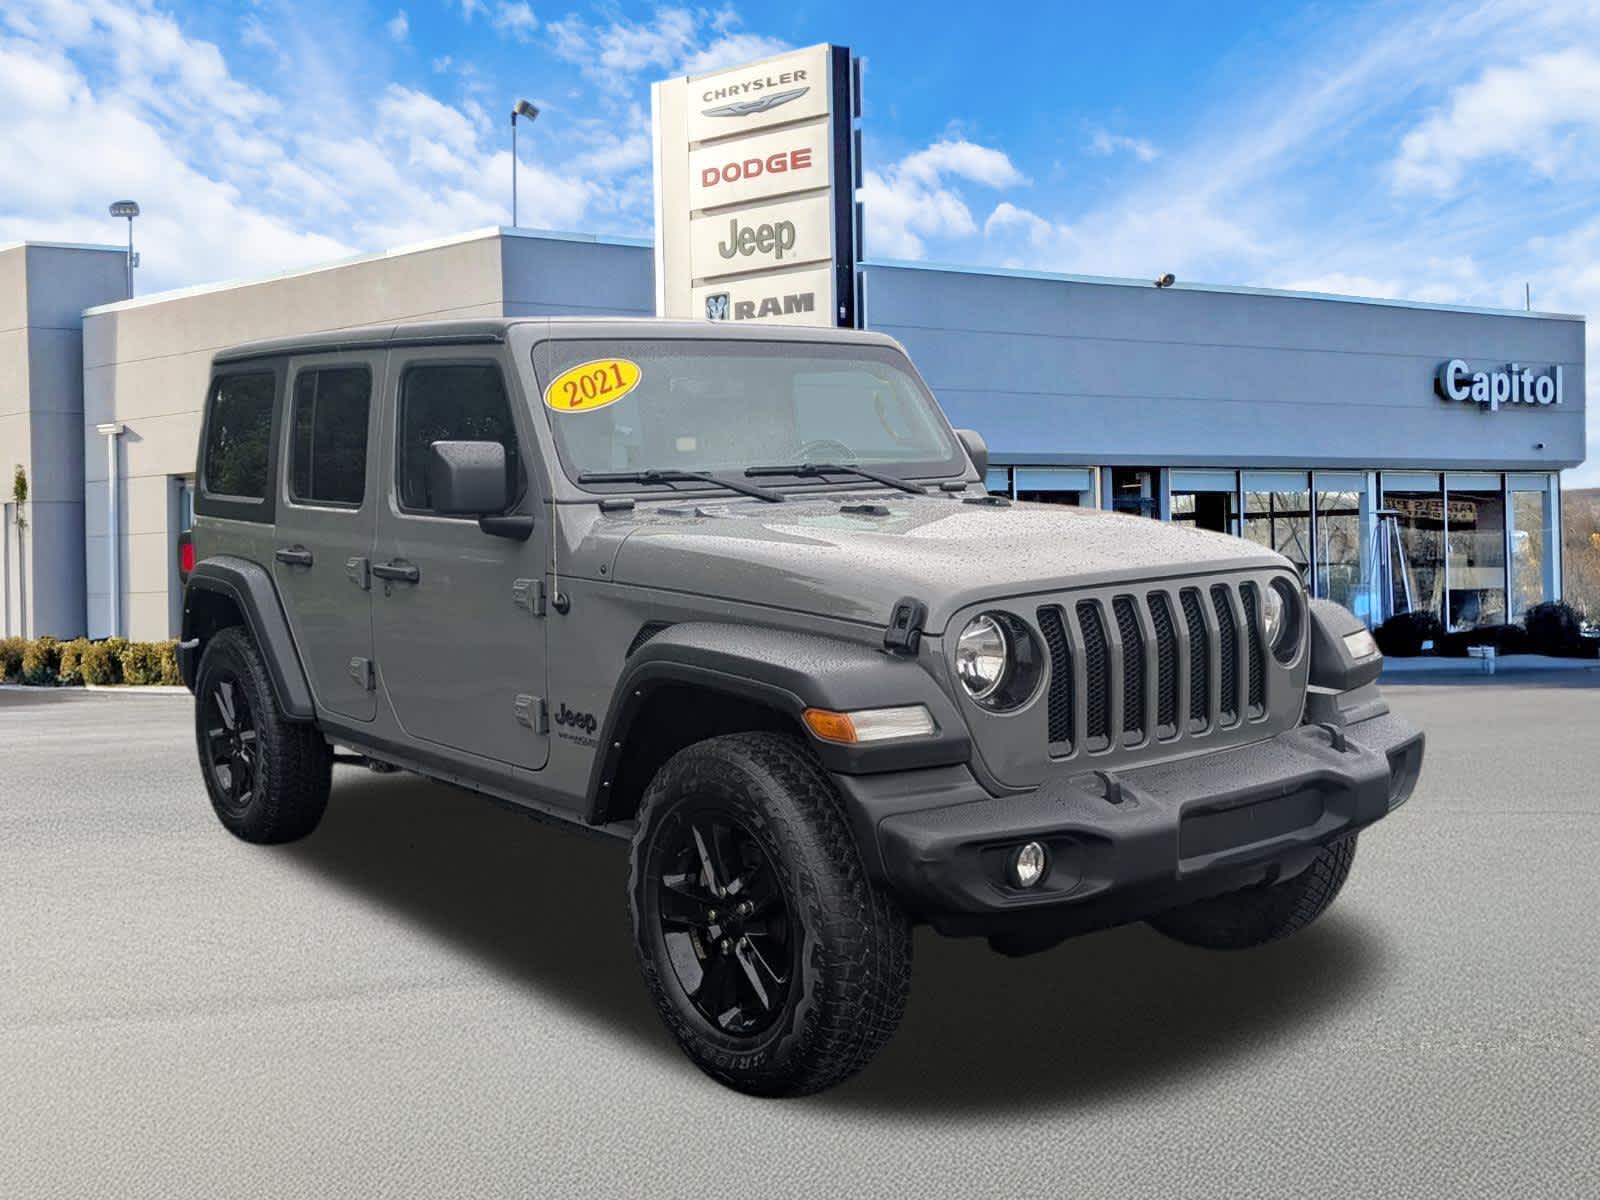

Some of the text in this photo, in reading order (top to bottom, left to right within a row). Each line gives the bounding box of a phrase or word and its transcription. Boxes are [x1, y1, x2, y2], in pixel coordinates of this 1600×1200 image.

[702, 69, 808, 102] CHRYSLER
[702, 148, 812, 188] DODGE
[718, 219, 795, 259] Jeep
[734, 293, 815, 320] RAM
[563, 363, 627, 407] 2021
[1446, 359, 1563, 411] Capitol
[555, 703, 597, 735] Jeep
